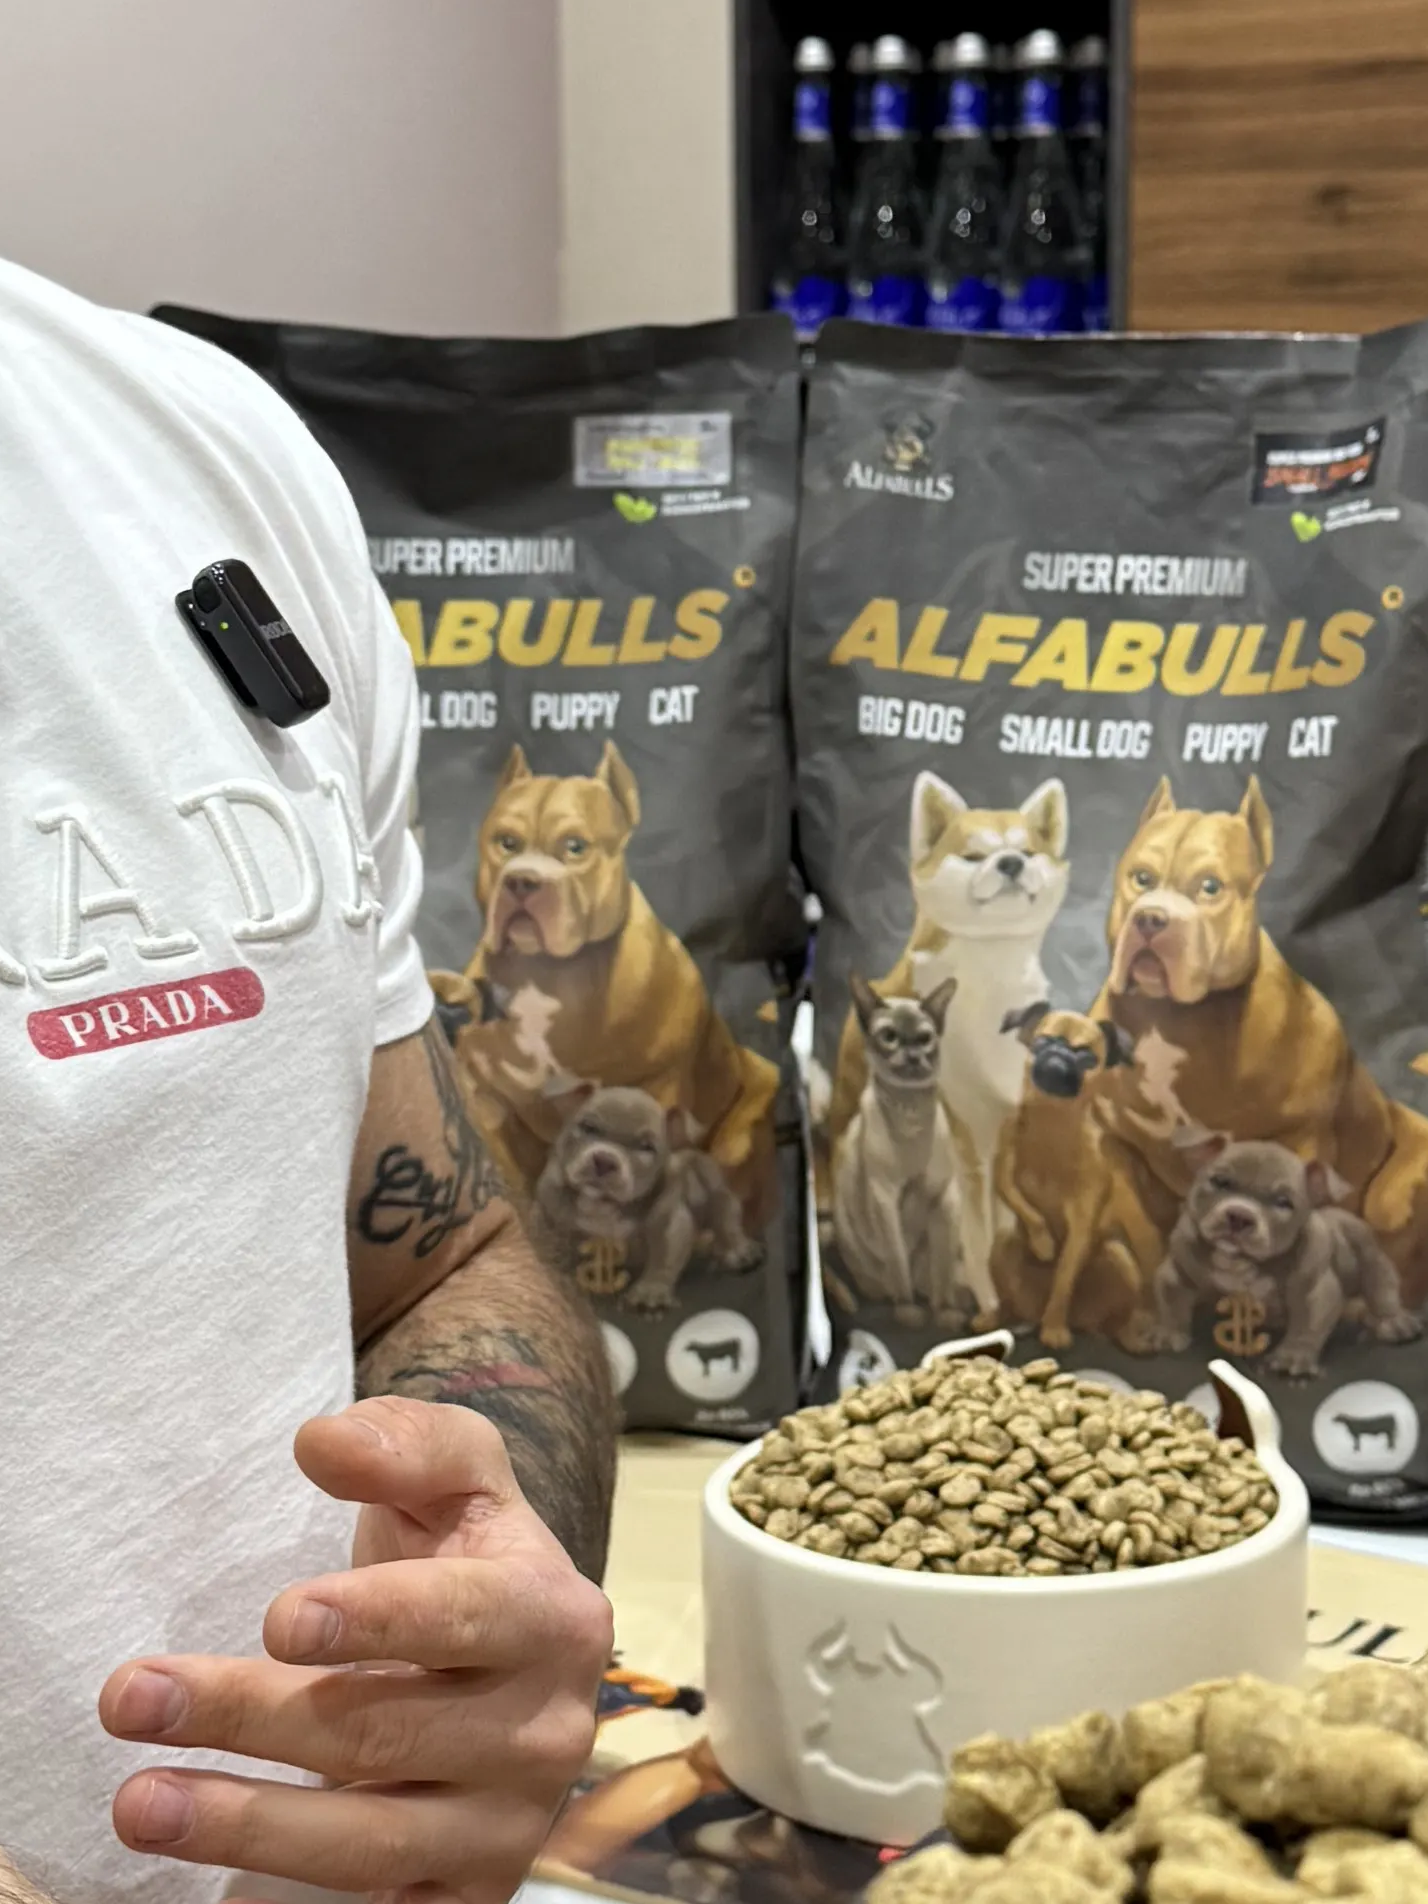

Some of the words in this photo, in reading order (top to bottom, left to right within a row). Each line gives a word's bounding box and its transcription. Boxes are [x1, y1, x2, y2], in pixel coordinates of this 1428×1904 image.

[445, 535, 575, 576] PREMIUM
[1022, 552, 1113, 594] SUPER
[1114, 554, 1250, 596] PREMIUM
[828, 597, 1376, 696] ALFABULLS
[440, 690, 499, 729] DOG
[530, 691, 620, 731] PUPPY
[648, 684, 700, 726] CAT
[858, 695, 905, 738] BIG
[903, 698, 966, 745] DOG
[999, 713, 1092, 758] SMALL
[1096, 719, 1153, 759] DOG
[1182, 721, 1269, 763] PUPPY
[1288, 715, 1339, 758] CAT
[59, 984, 233, 1048] PRADA
